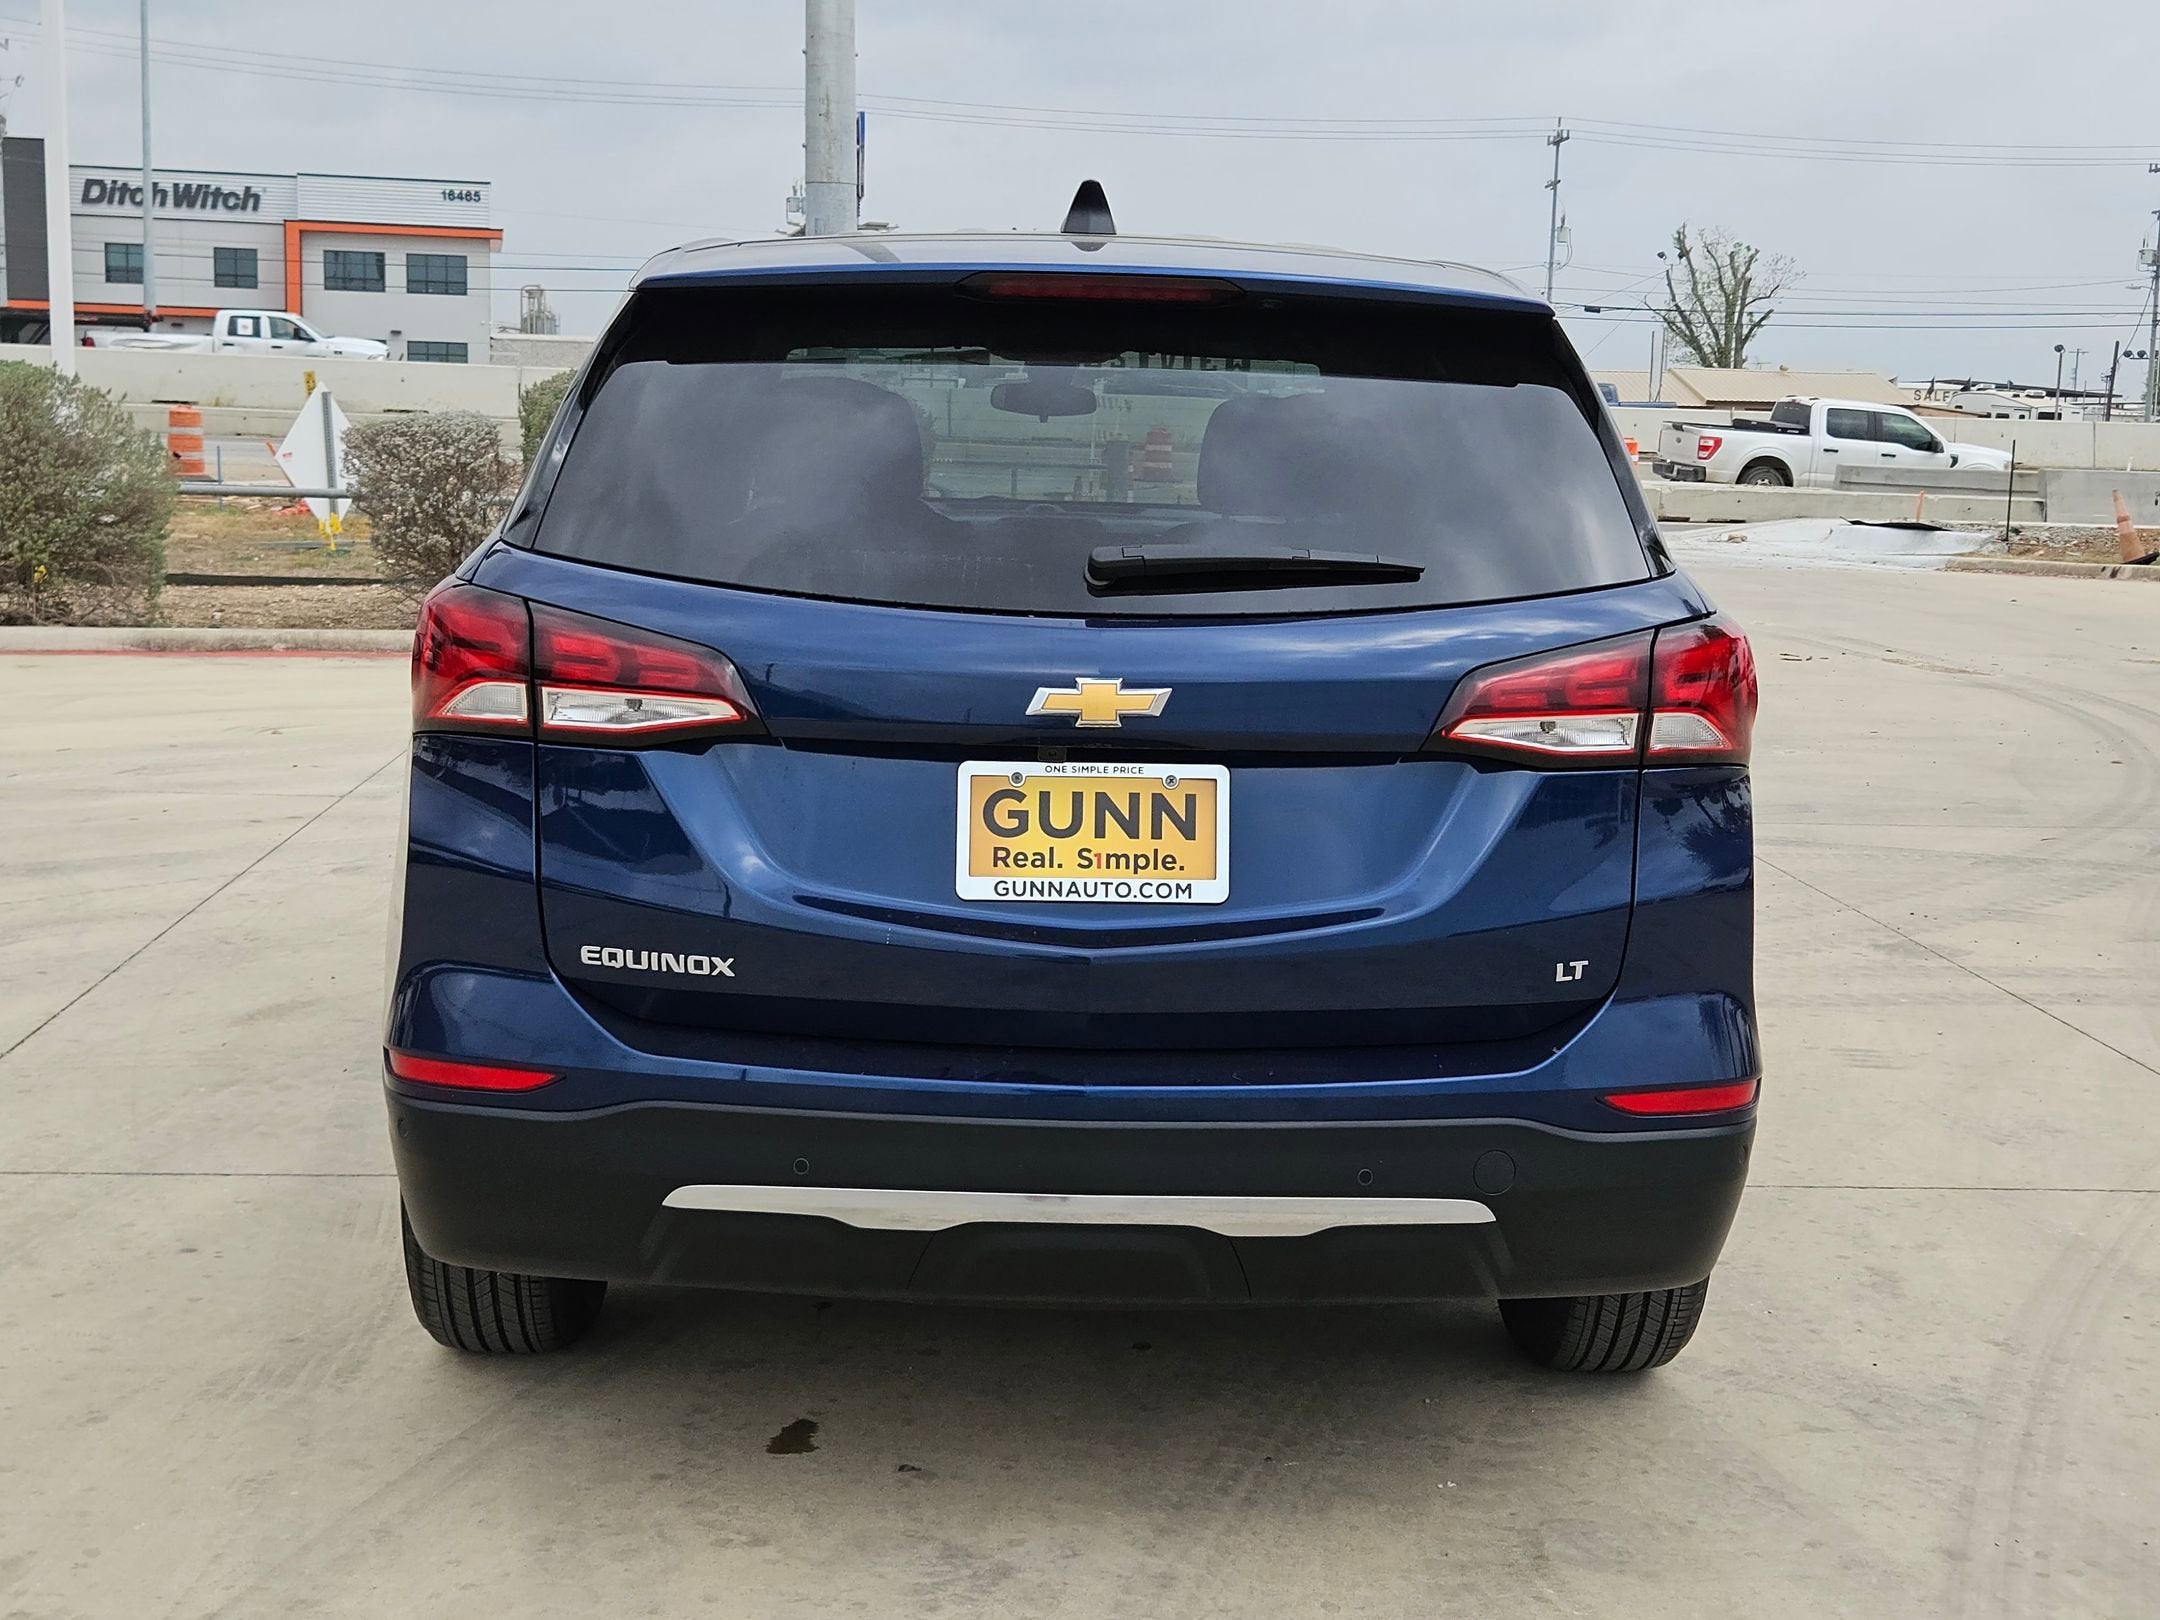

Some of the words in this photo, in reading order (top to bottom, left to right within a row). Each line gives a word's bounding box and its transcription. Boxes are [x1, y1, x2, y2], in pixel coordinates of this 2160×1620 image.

[81, 178, 168, 208] Ditch
[173, 182, 261, 212] Witch
[441, 189, 481, 202] 16465
[1045, 765, 1068, 774] ONE
[1071, 765, 1109, 774] SIMPLE
[1113, 766, 1145, 775] PRICE
[982, 788, 1197, 841] GUNN
[992, 846, 1063, 869] Real.
[993, 880, 1192, 899] GUNNAUTO.COM
[580, 945, 736, 977] EQUINOX
[1555, 960, 1589, 982] LT
